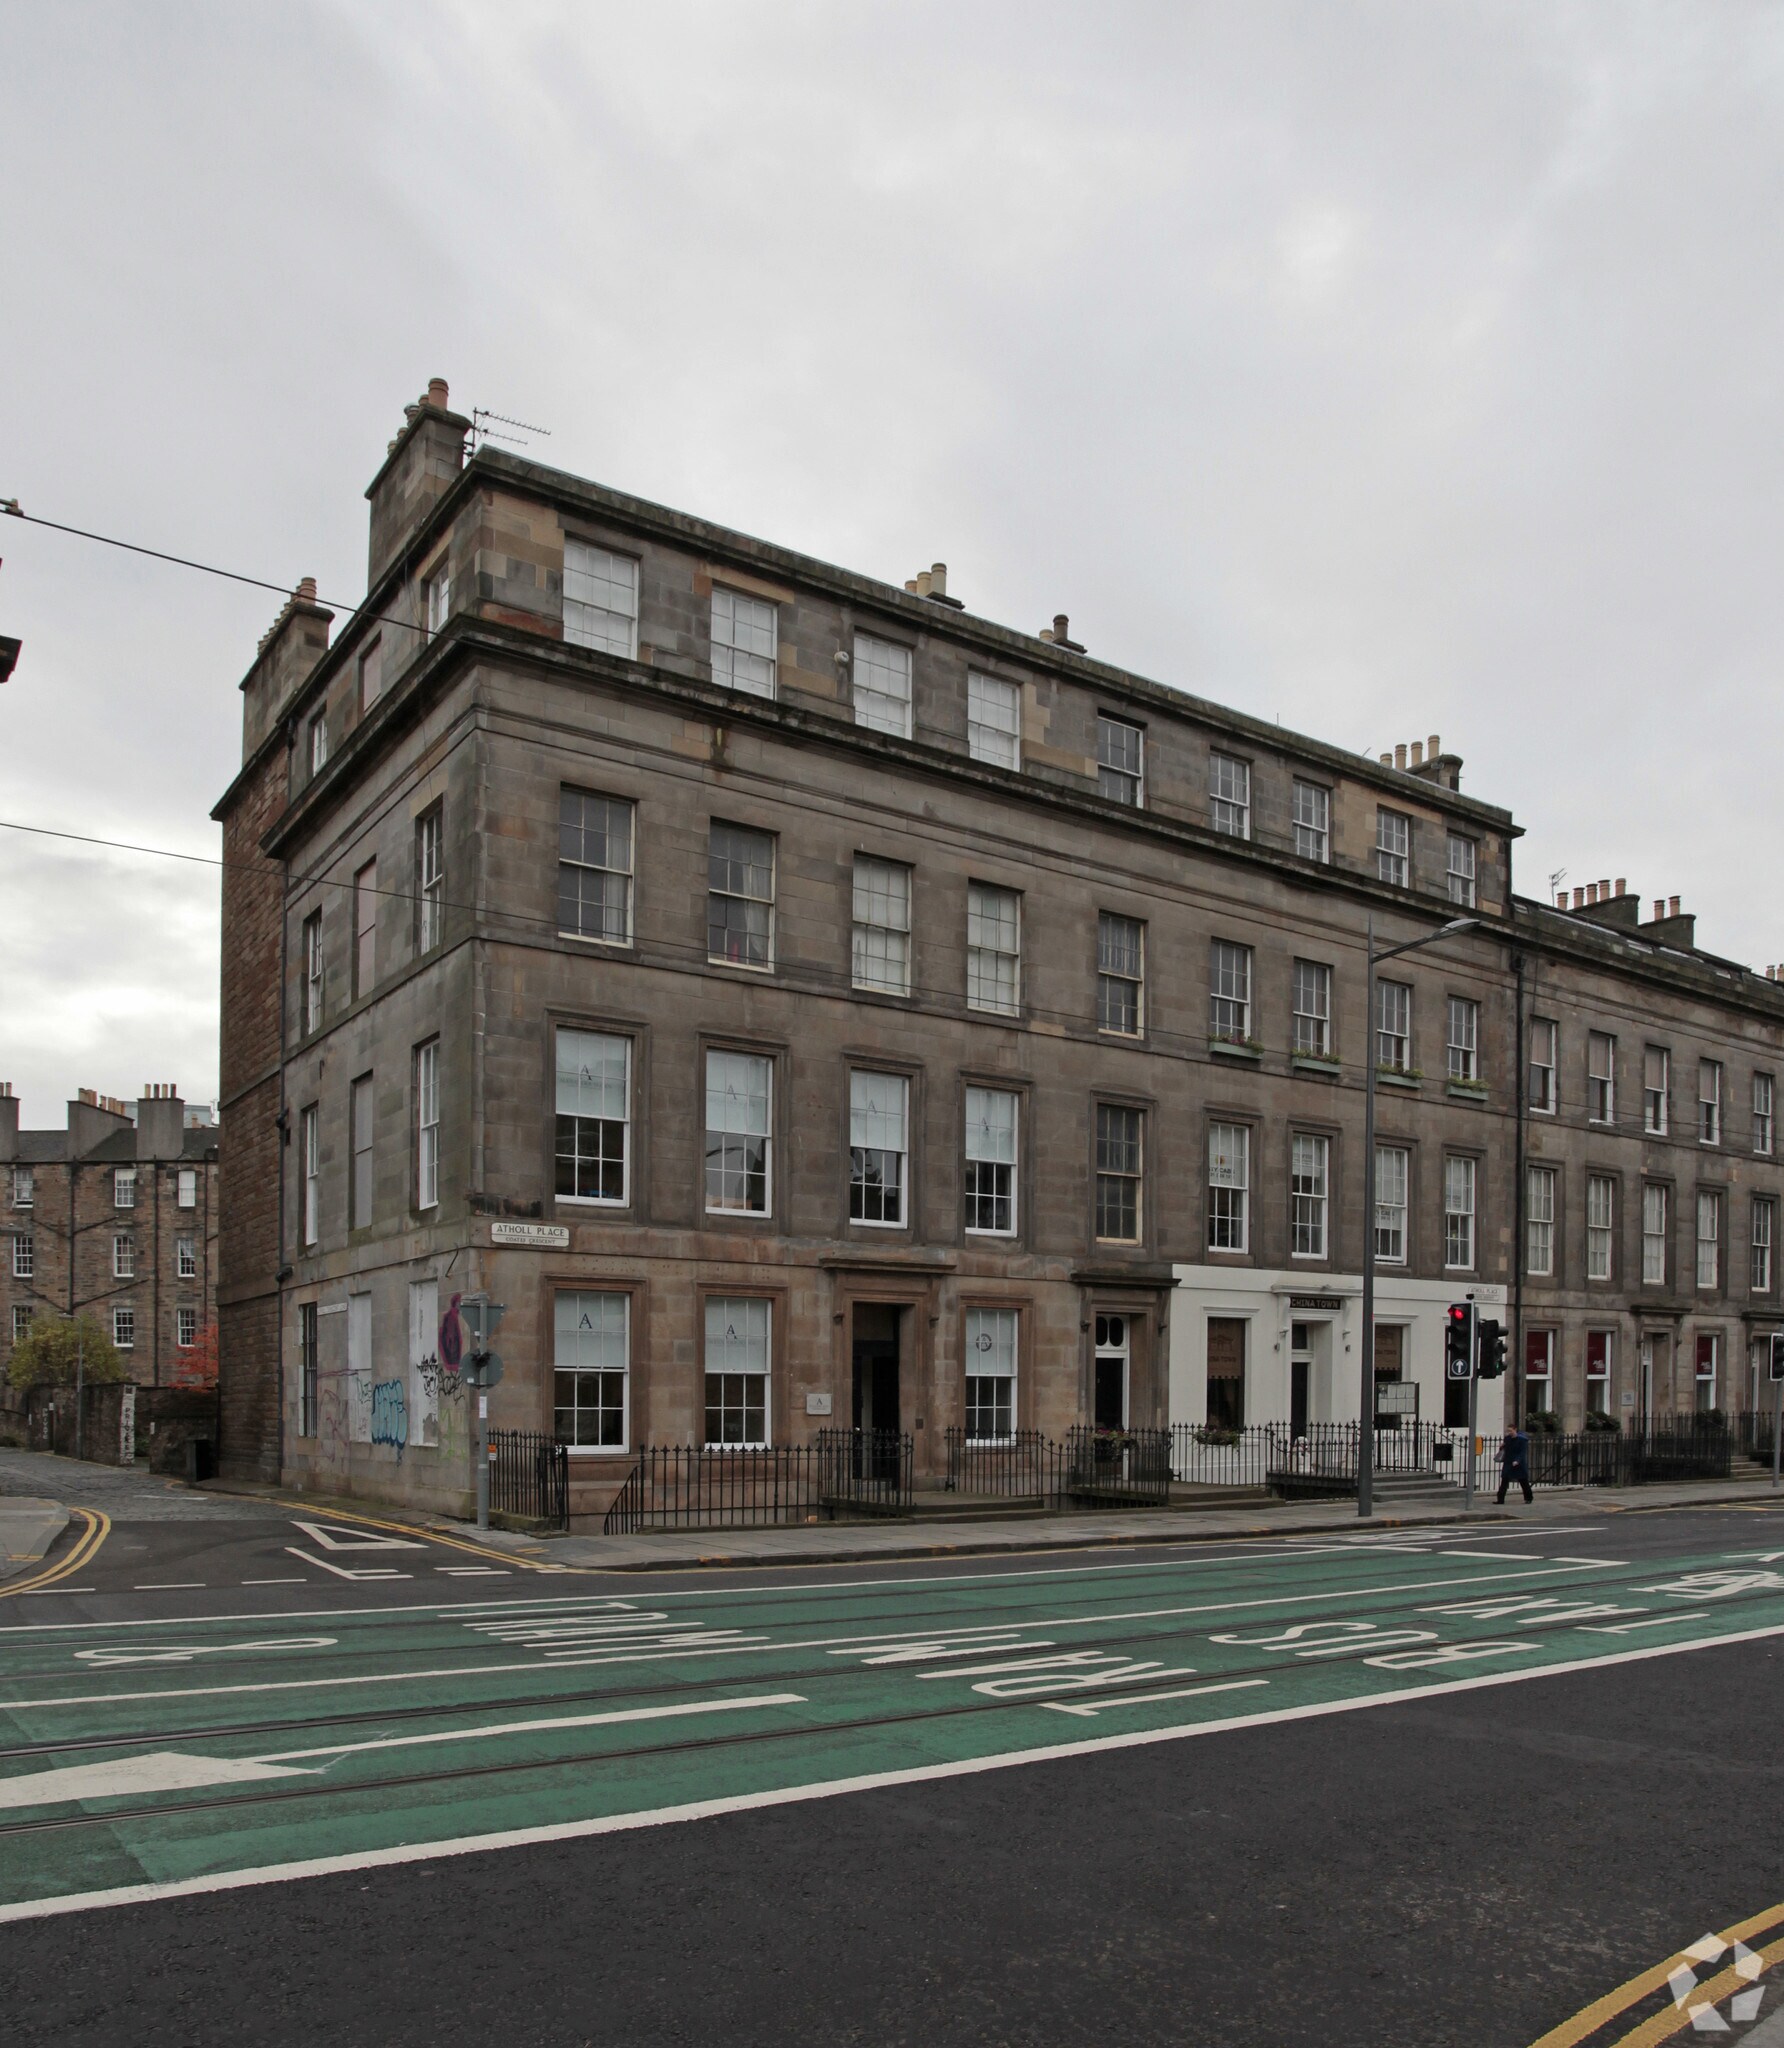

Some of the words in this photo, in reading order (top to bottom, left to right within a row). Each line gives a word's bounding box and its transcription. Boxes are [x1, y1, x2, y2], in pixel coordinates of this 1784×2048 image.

[496, 1224, 532, 1235] ATHOLL
[536, 1226, 565, 1237] PLACE
[528, 1237, 556, 1245] CRESCENT
[1291, 1298, 1316, 1308] CHINA
[1316, 1299, 1339, 1309] TOWN
[579, 1313, 593, 1329] A
[725, 1324, 737, 1340] A
[1413, 1596, 1710, 1635] TAXI
[437, 1601, 771, 1657] TRAM
[1208, 1621, 1544, 1670] BUS
[826, 1633, 1270, 1717] TRAM
